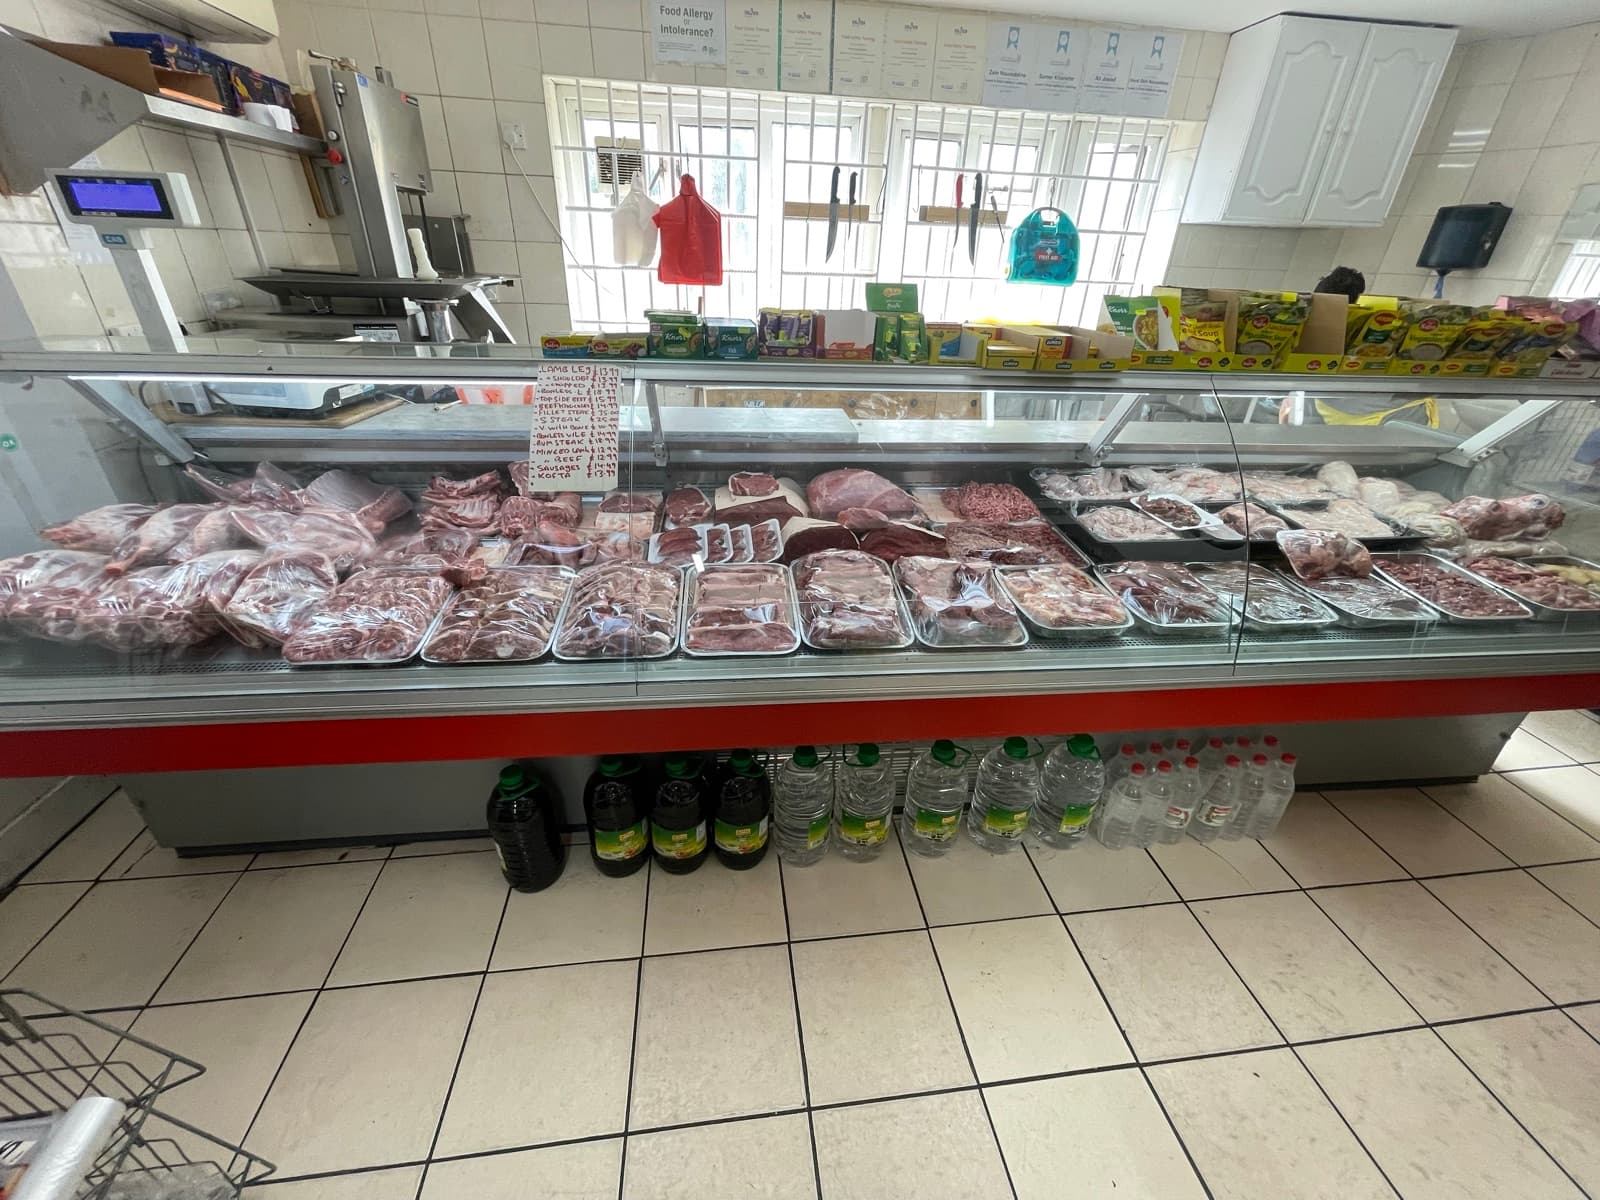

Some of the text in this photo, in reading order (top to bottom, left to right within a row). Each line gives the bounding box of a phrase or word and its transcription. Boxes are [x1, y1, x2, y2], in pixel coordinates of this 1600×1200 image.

[660, 5, 713, 20] Food Allergy
[660, 24, 714, 38] Intolerance?
[1108, 305, 1128, 314] Knorr
[664, 332, 686, 342] Knorr
[721, 334, 742, 342] Knorr
